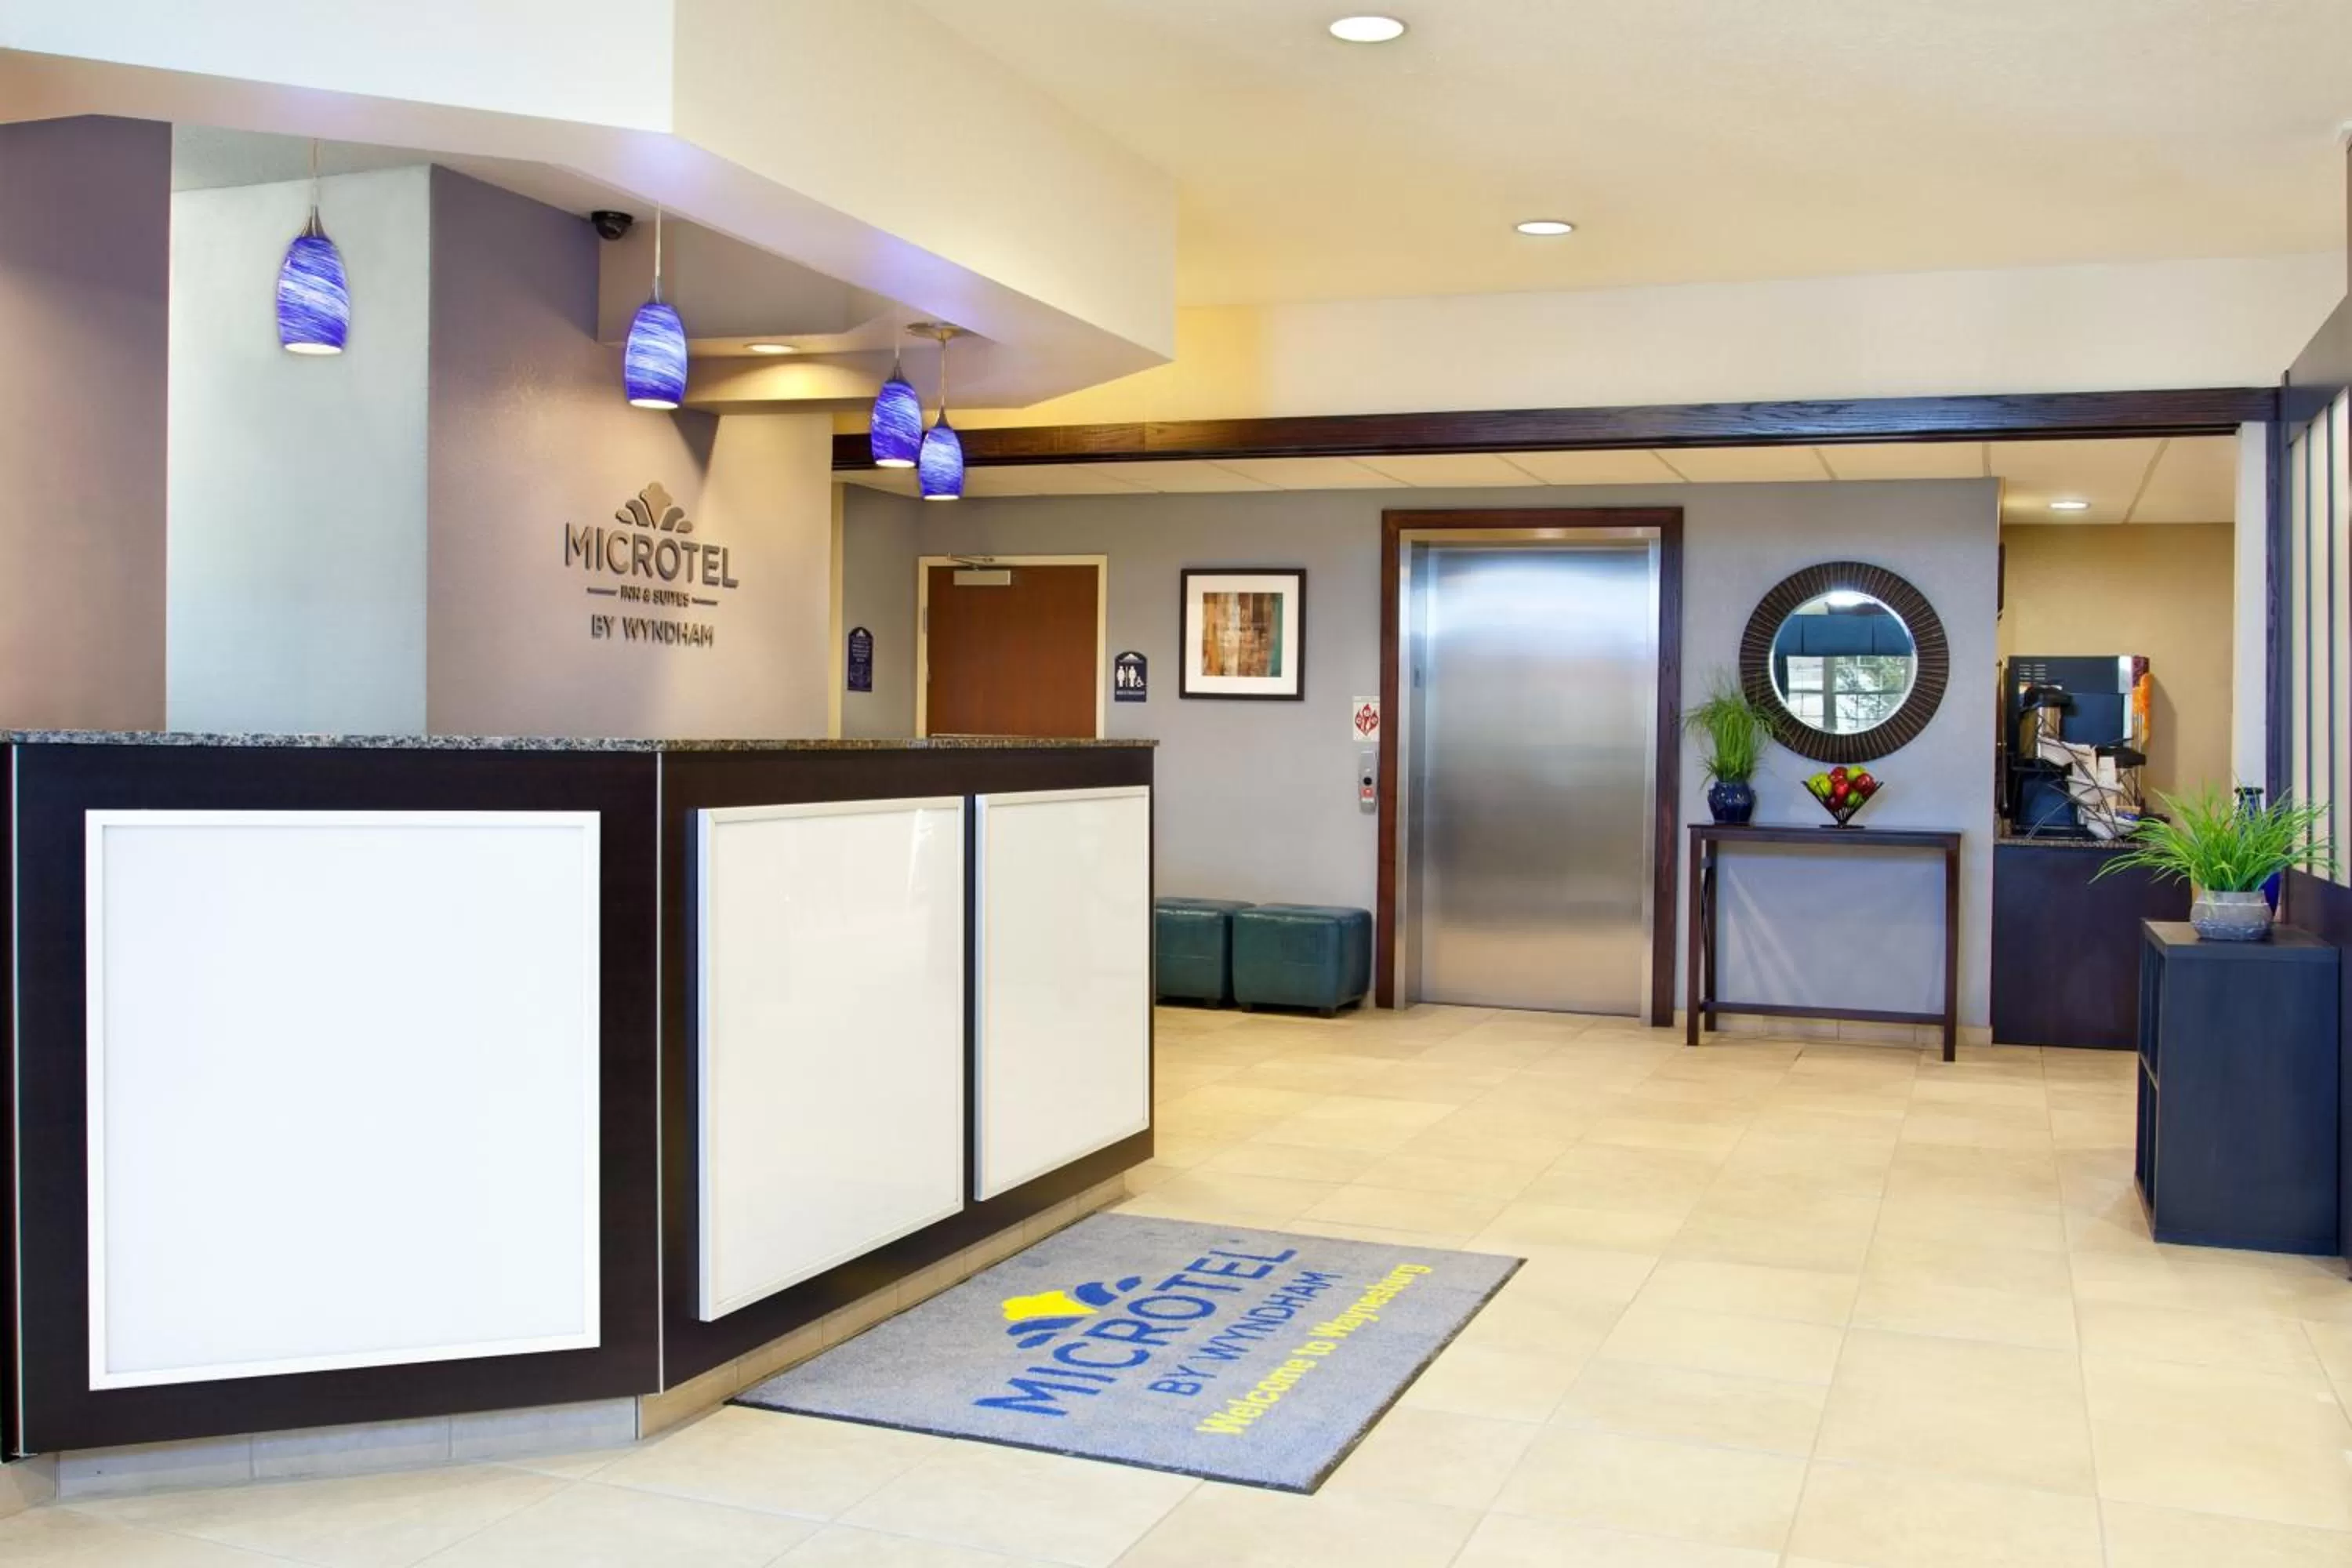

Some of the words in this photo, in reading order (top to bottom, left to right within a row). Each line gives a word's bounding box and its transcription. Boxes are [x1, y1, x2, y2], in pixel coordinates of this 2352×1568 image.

[564, 521, 739, 589] MICROTEL
[591, 614, 615, 640] BY
[622, 616, 714, 648] WYNDHAM
[620, 584, 641, 602] INN
[653, 590, 690, 608] SUITES
[973, 1249, 1298, 1417] MICROTEL
[1147, 1364, 1217, 1396] BY
[1189, 1270, 1342, 1360] WYNDHAM
[1308, 1262, 1433, 1339] Waynesburg
[1291, 1340, 1338, 1356] to
[1196, 1358, 1317, 1435] Welcome
